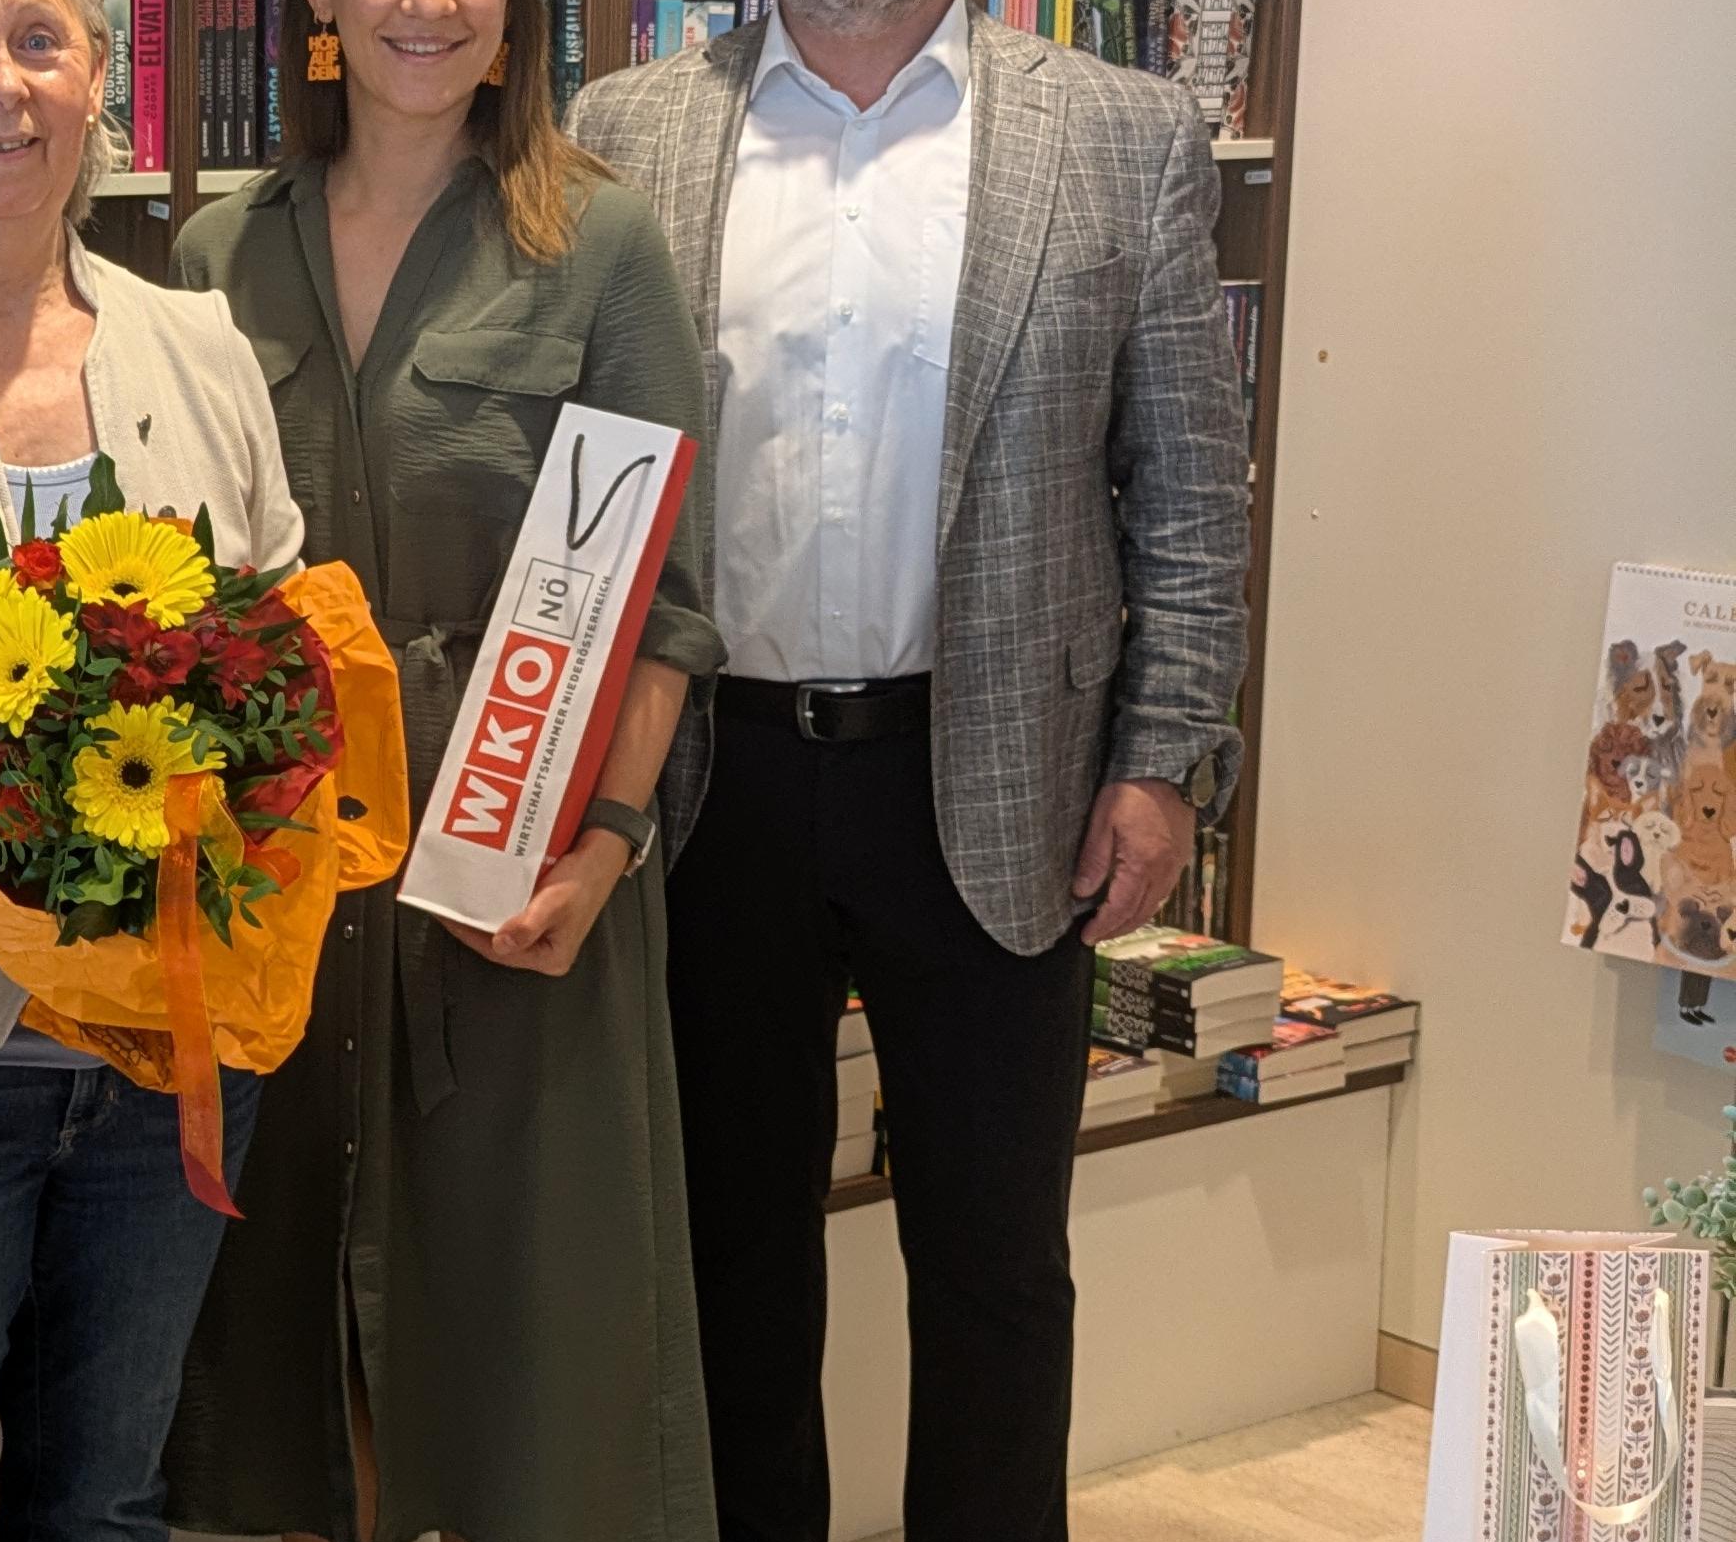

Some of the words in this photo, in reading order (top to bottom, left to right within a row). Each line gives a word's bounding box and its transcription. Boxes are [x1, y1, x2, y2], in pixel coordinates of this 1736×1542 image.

[115, 30, 126, 105] SCHWARM
[308, 33, 339, 52] HÖR
[310, 50, 339, 66] AUF
[308, 65, 341, 82] DEIN
[268, 67, 282, 143] PODCAST
[537, 576, 570, 623] NÖ
[451, 644, 554, 838] WKO
[515, 707, 569, 858] WIRTSCHAFTSKAMMER
[565, 575, 613, 706] NIEDERÖSTERREICH
